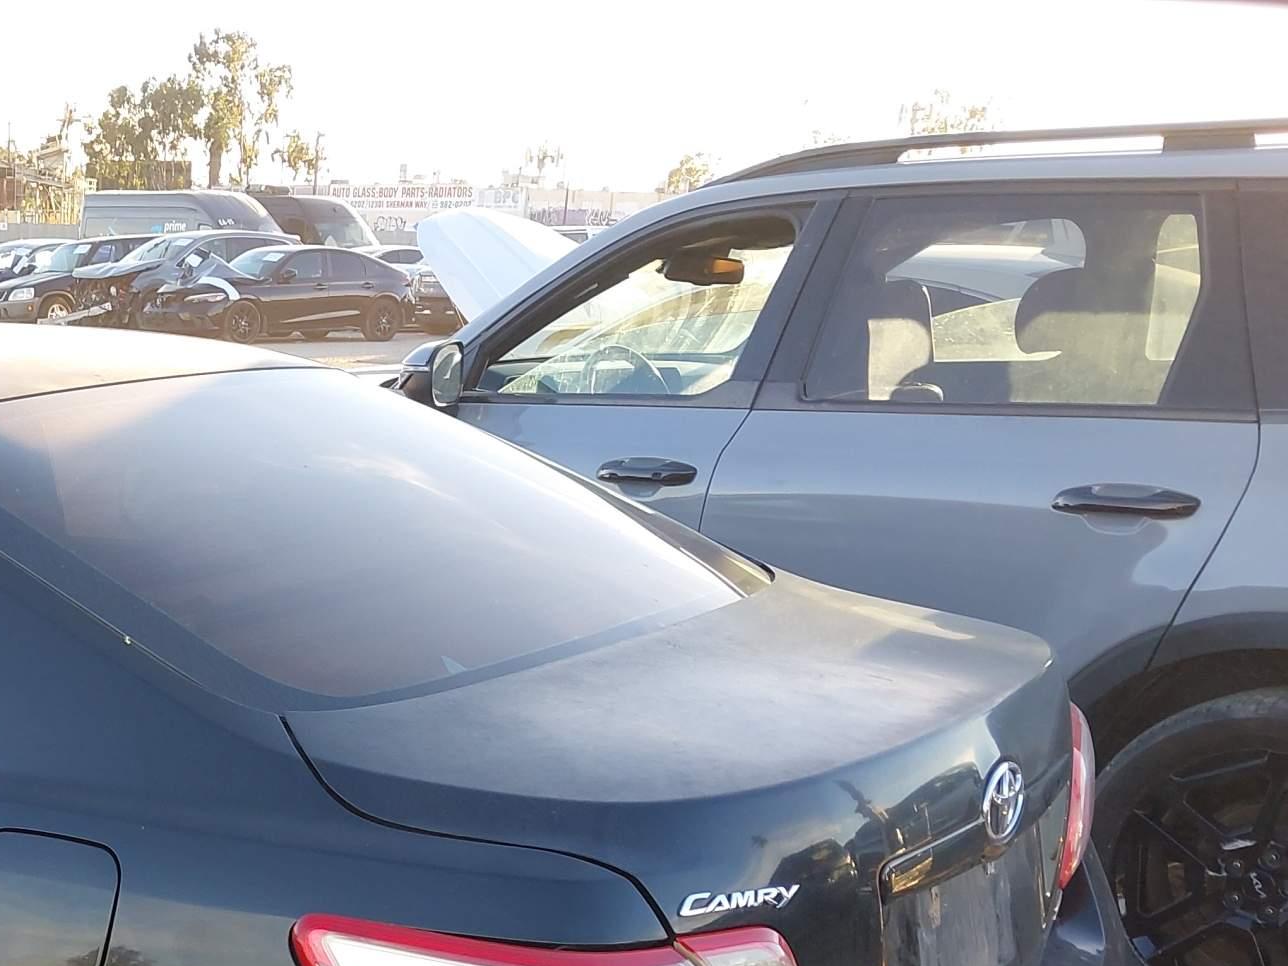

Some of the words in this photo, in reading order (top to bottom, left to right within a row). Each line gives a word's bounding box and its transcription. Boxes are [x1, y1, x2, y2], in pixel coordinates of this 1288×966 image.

[332, 186, 351, 198] AUTO
[386, 200, 414, 209] SHERMAN
[164, 220, 187, 233] prime
[679, 883, 801, 917] CAMRY
